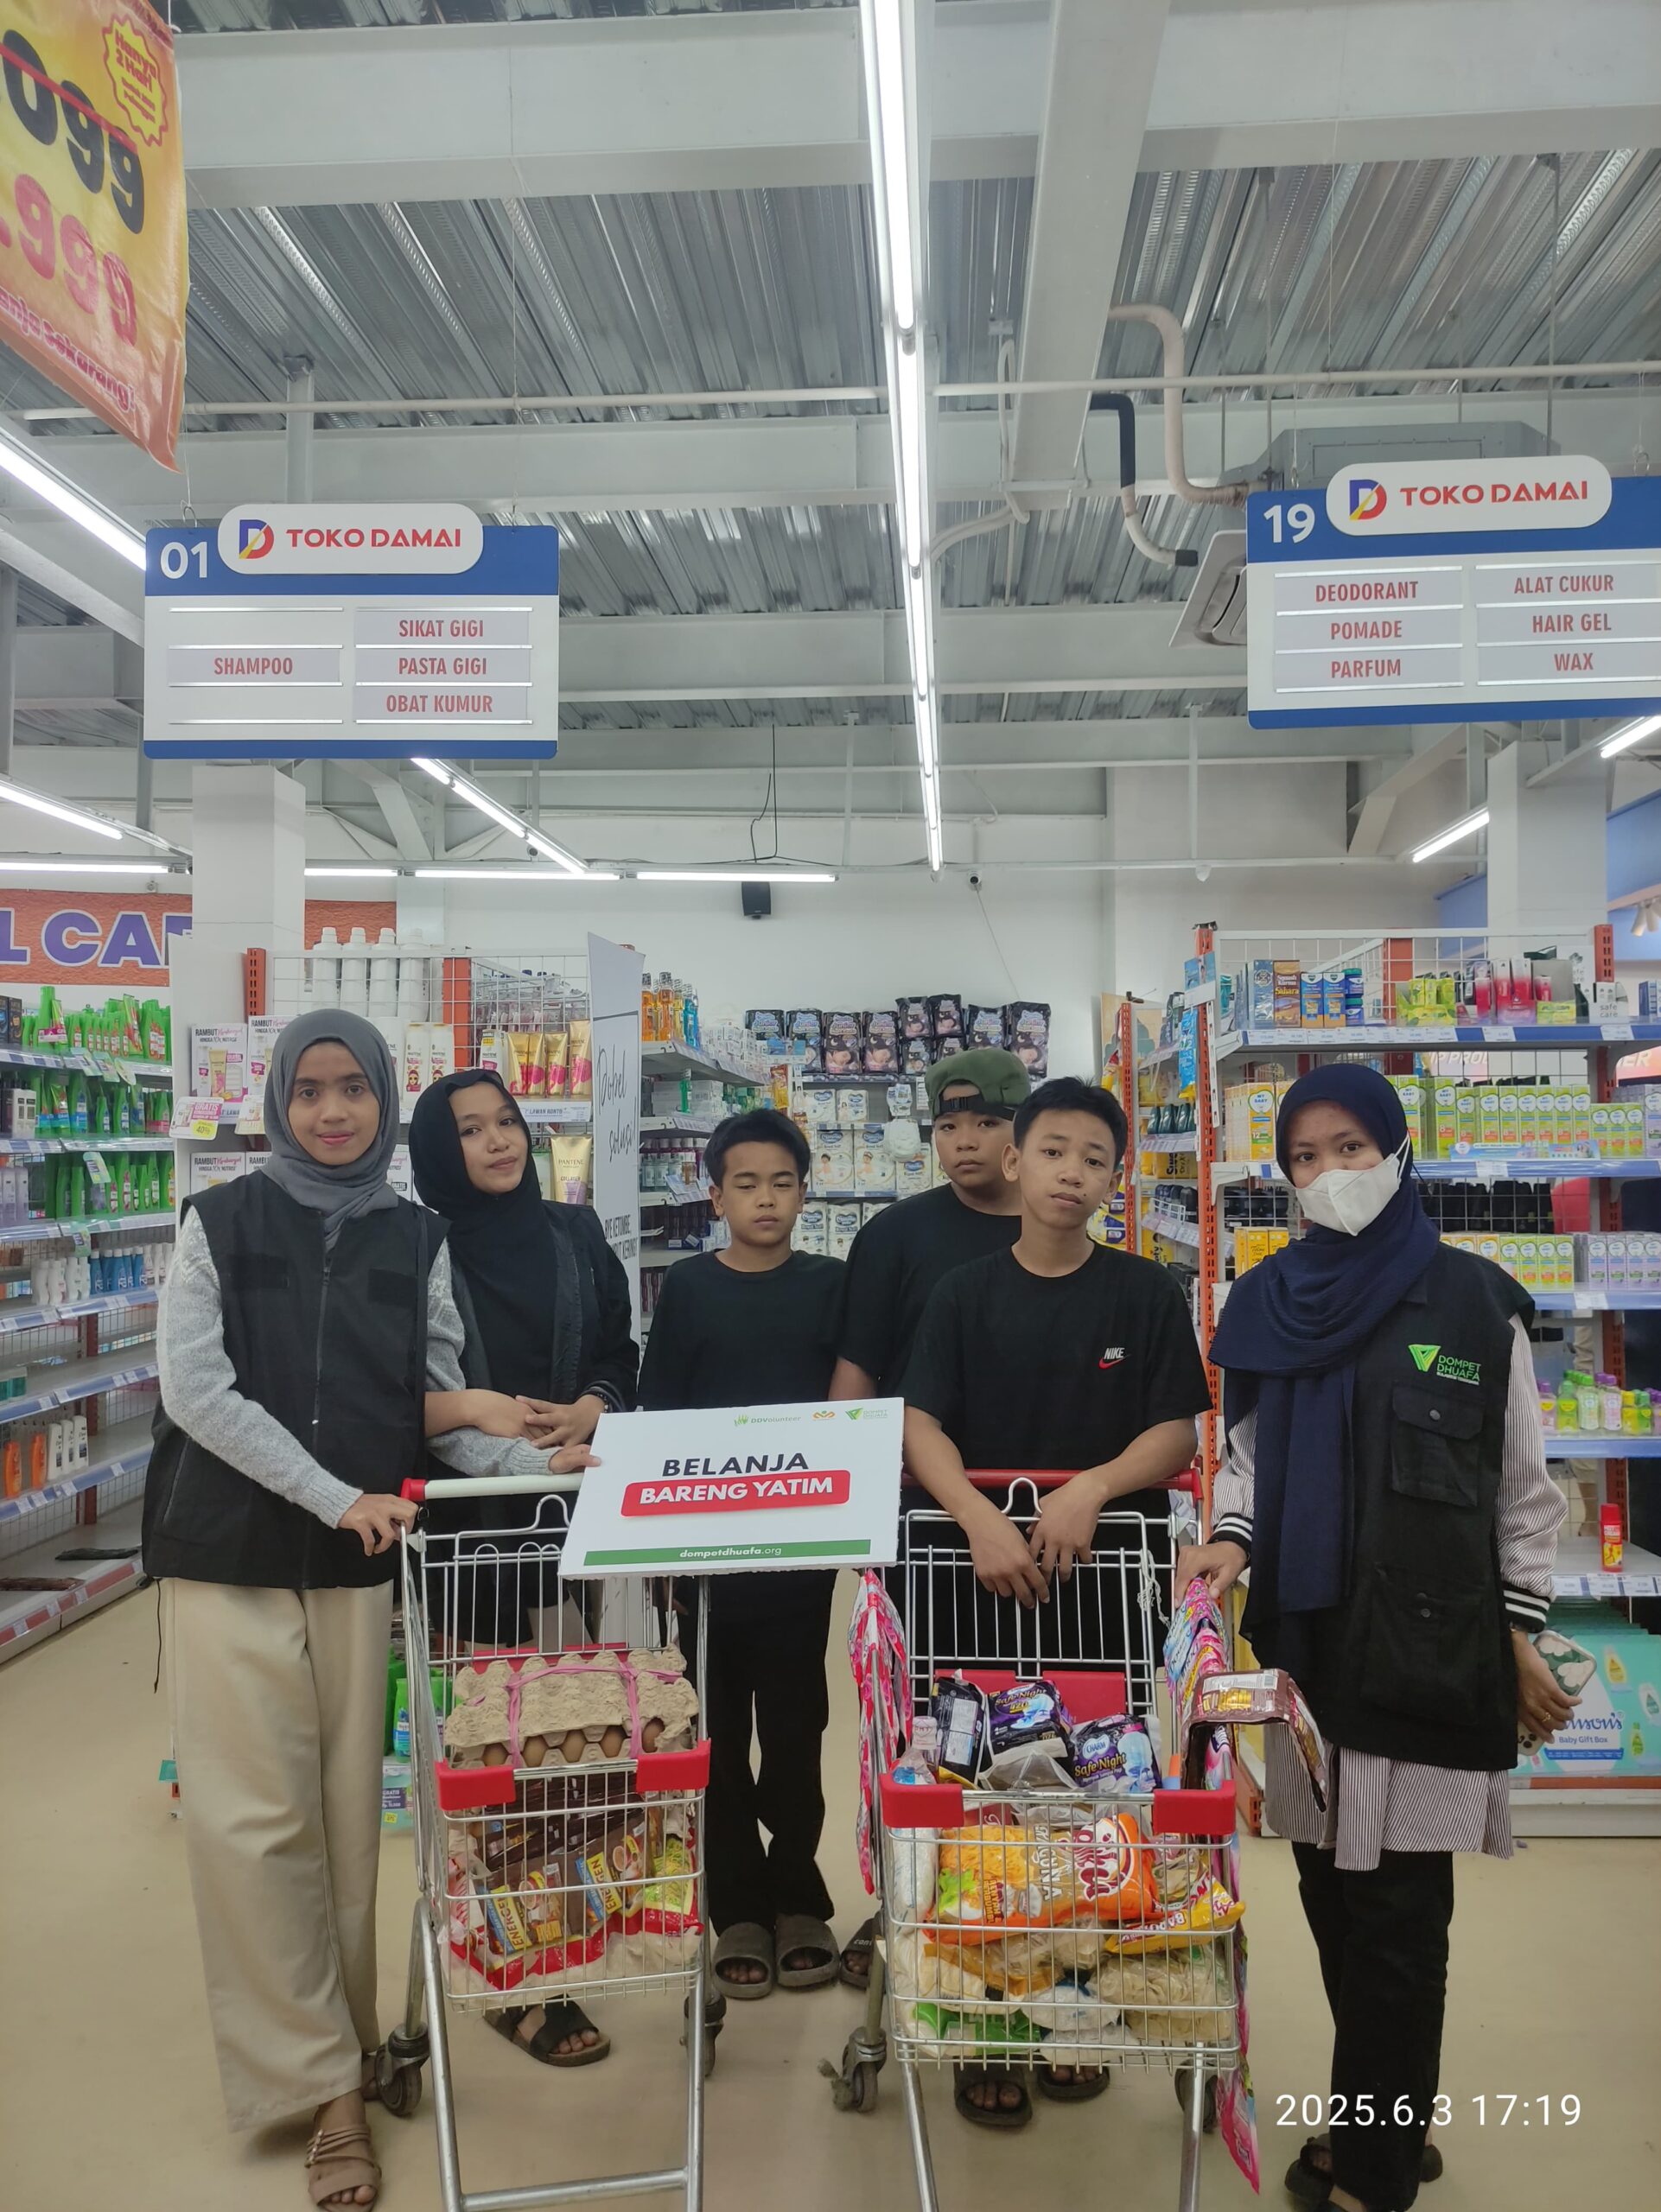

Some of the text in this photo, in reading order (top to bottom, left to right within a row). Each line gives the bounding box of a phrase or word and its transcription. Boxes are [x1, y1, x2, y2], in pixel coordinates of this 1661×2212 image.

[1400, 485, 1485, 506] TOKO
[1491, 480, 1588, 503] DAMAI
[1263, 504, 1315, 543] 19
[286, 528, 365, 548] TOKO
[371, 528, 461, 548] DAMAI
[160, 541, 208, 579] 01
[1315, 581, 1419, 602] DEODORANT
[1514, 575, 1614, 594] ALAT CUKUR
[398, 620, 484, 638] SIKAT GIGI
[1330, 620, 1403, 640] POMADE
[1532, 613, 1612, 633] HAIR GEL
[213, 658, 293, 676] SHAMPOO
[398, 658, 487, 675] PASTA GIGI
[1331, 658, 1402, 678] PARFUM
[1554, 652, 1594, 671] WAX
[386, 695, 493, 713] OBAT KUMUR
[1276, 987, 1300, 995] Sahara
[194, 1157, 217, 1166] RAMBUT
[1104, 1347, 1125, 1360] NIKE
[1436, 1363, 1480, 1382] DHUAFA
[1438, 1355, 1481, 1372] DOMPET
[662, 1452, 809, 1477] BELANJA
[640, 1477, 833, 1504] BARENG YATIM
[679, 1546, 782, 1560] dompetdhuafa.org
[1085, 1741, 1106, 1753] CHARM
[1558, 1736, 1577, 1745] Baby
[1074, 1762, 1098, 1777] Safe
[1098, 1751, 1127, 1771] Night
